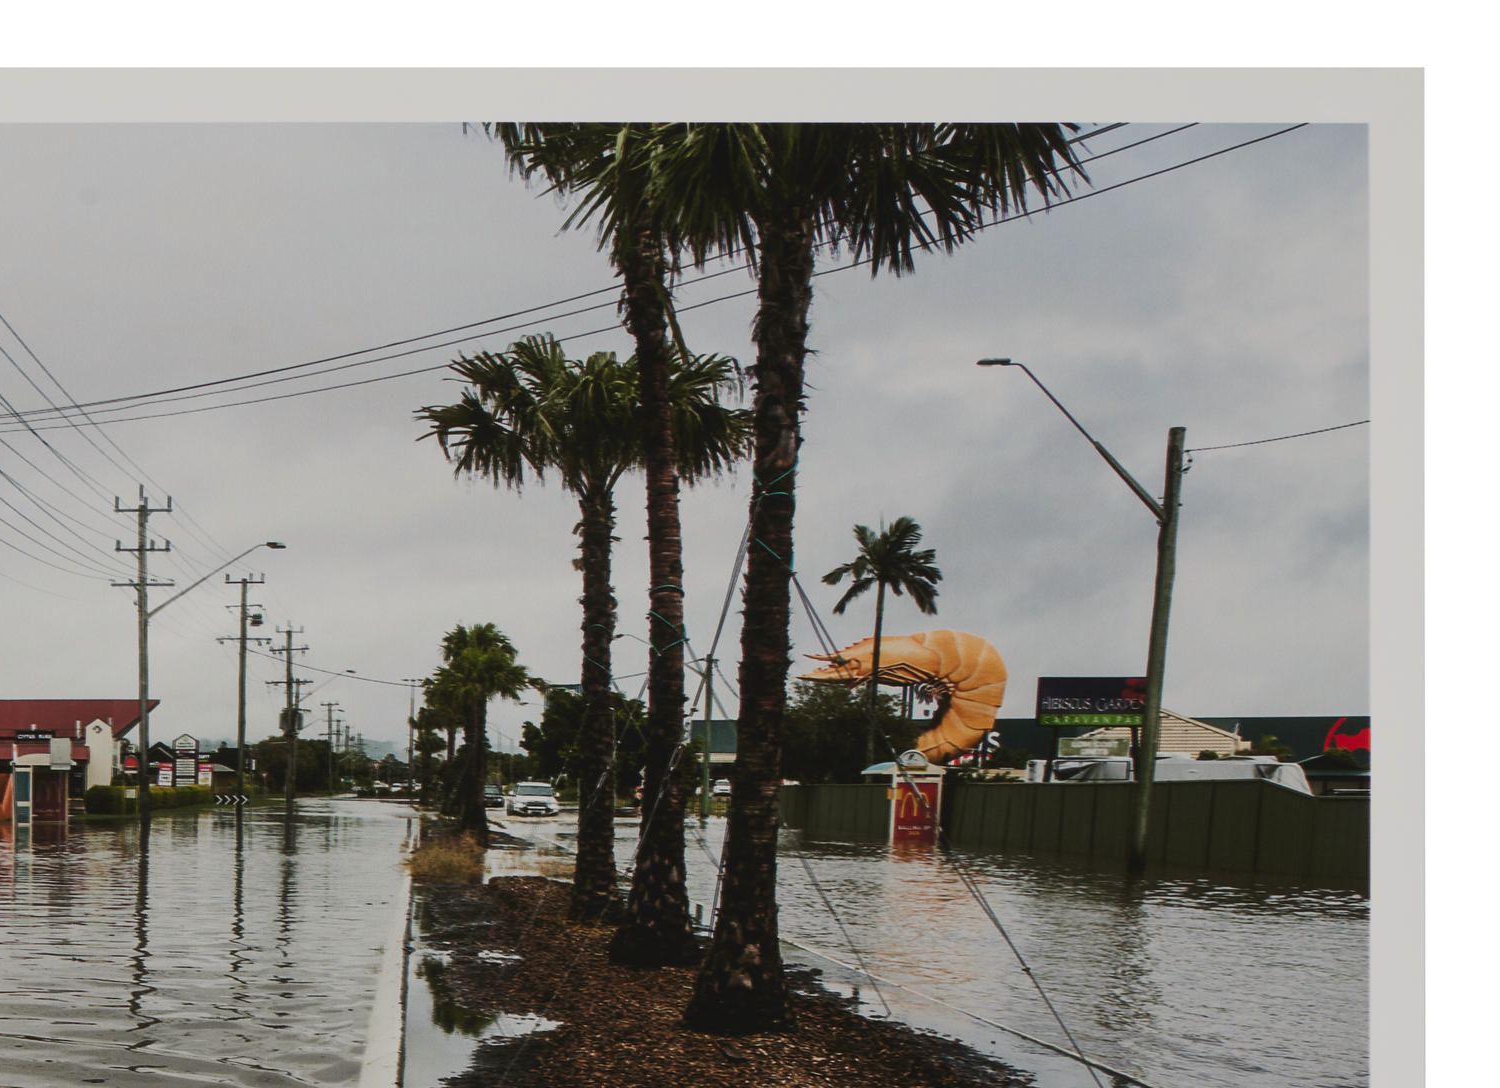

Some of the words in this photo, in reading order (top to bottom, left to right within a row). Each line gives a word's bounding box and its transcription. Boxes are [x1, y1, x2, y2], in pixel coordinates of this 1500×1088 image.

[1041, 696, 1092, 710] HIBISCUS
[1044, 715, 1109, 724] CARAVAN
[1115, 715, 1142, 724] PAR
